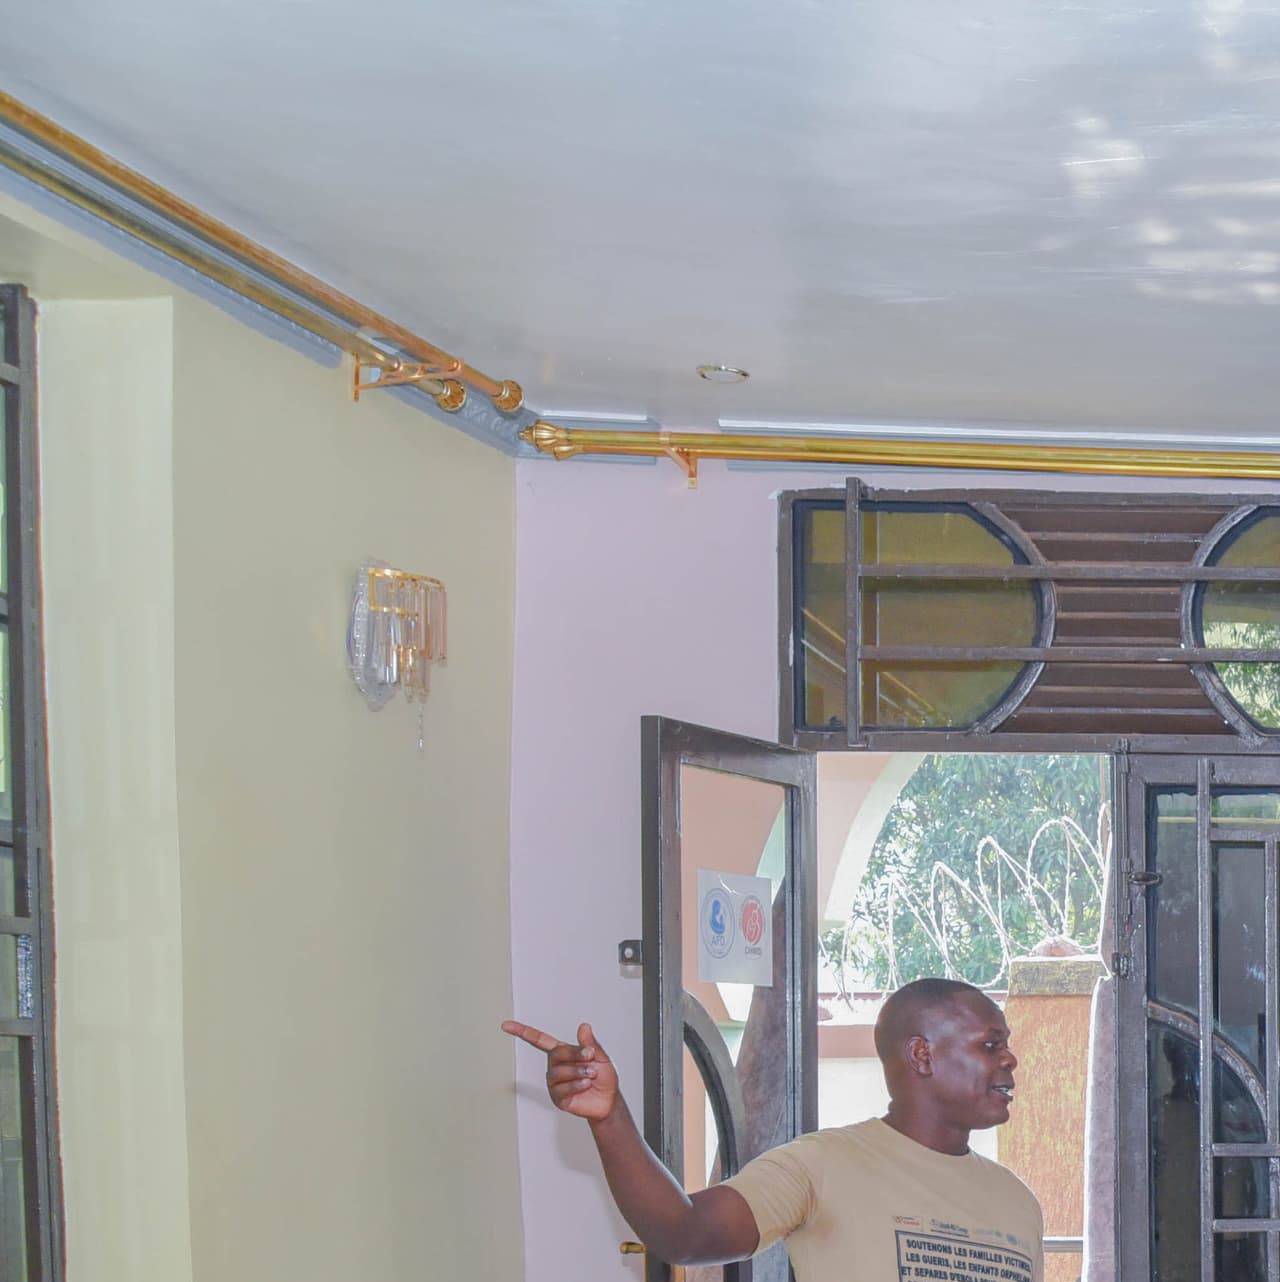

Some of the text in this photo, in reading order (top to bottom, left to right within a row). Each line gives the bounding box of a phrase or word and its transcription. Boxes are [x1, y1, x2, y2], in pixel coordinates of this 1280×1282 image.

[906, 1238, 953, 1255] SOUTENONS
[954, 1246, 968, 1258] LES
[969, 1249, 1003, 1264] FAMILLES
[900, 1265, 912, 1276] ET
[914, 1266, 949, 1281] SEPARES
[905, 1251, 921, 1263] LES
[953, 1259, 967, 1271] LES
[968, 1262, 1000, 1278] ENFANTS
